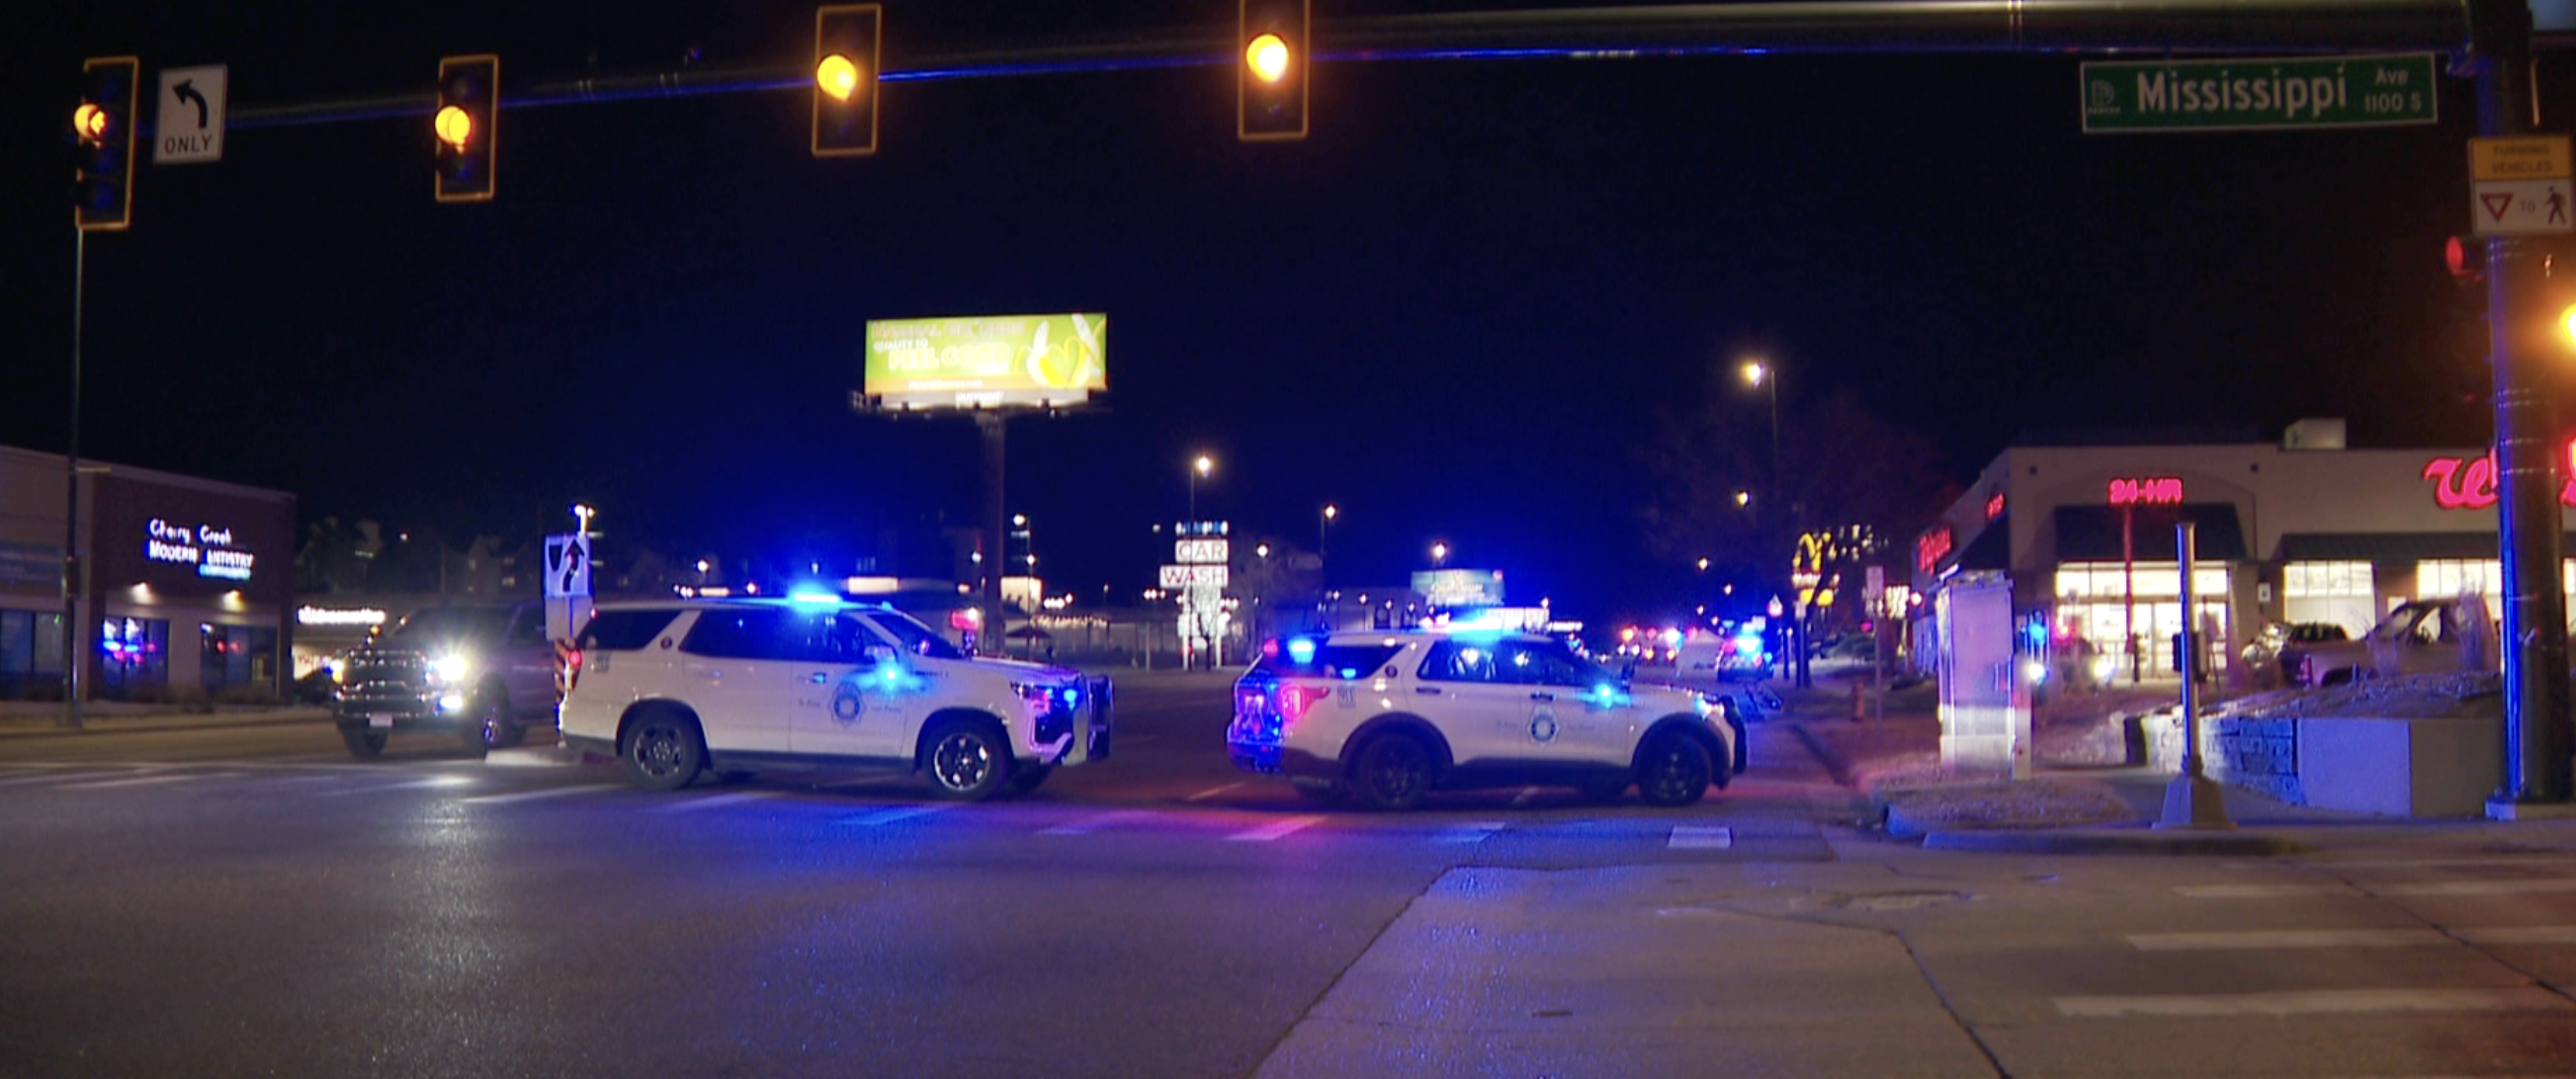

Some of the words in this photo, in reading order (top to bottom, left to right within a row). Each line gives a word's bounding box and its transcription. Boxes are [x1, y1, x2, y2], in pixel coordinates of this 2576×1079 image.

[2375, 67, 2409, 85] Ave
[2137, 65, 2348, 119] Mississippi
[2365, 92, 2404, 114] 1100
[2410, 92, 2423, 112] S
[164, 133, 213, 155] ONLY
[2520, 200, 2536, 213] TO
[1178, 541, 1226, 561] CAR
[1162, 566, 1226, 586] WASH
